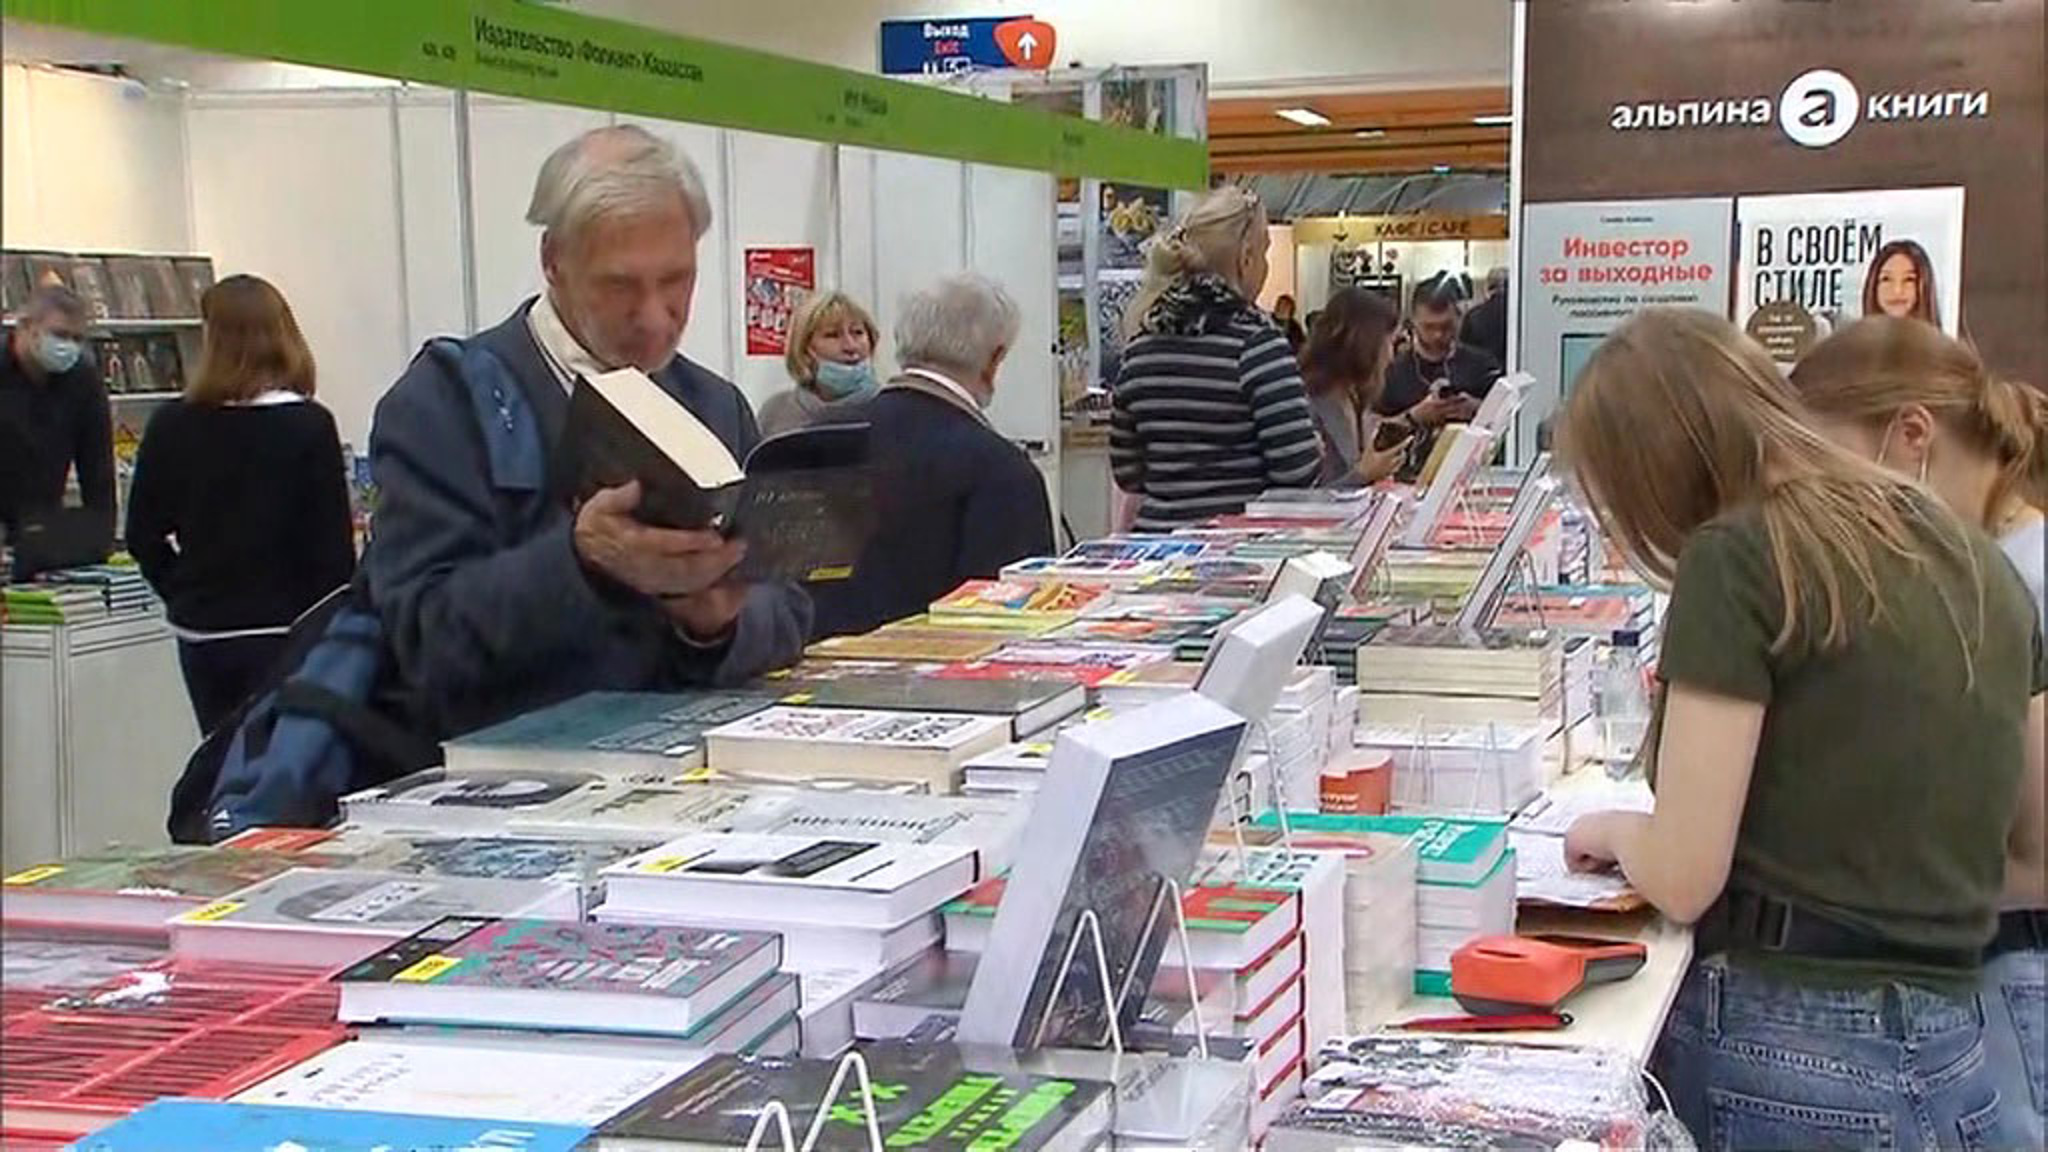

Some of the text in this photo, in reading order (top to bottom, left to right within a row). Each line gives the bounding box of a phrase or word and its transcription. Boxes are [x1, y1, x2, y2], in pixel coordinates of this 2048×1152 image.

[923, 22, 970, 39] Выход
[1611, 97, 1771, 129] альпина
[1867, 90, 1989, 120] книги
[1563, 237, 1689, 260] Инвестор
[1757, 217, 1882, 267] В СВОЁМ
[1539, 263, 1713, 286] за выходные
[1755, 267, 1843, 311] СТИЛЕ
